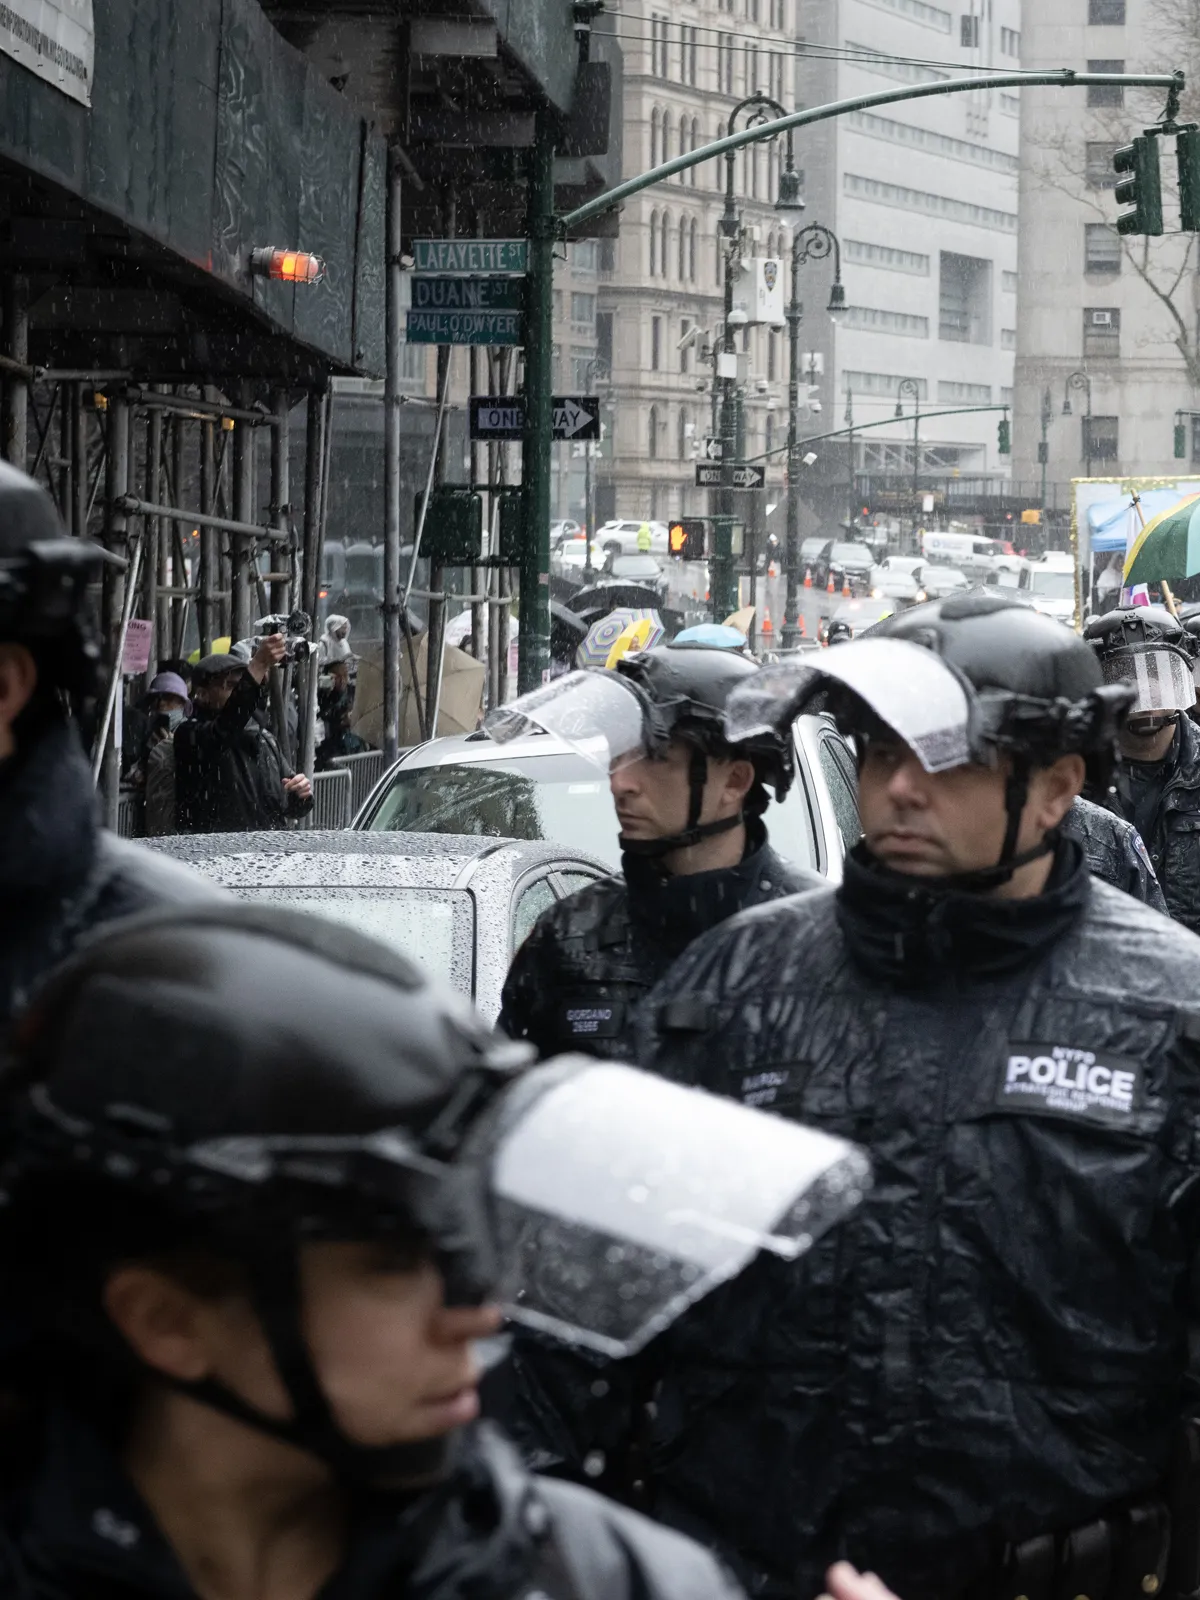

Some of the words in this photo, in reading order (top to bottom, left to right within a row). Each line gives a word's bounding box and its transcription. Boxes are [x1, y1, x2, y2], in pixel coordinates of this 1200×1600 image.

[416, 243, 507, 269] LAFAYETTE
[509, 243, 522, 257] ST
[416, 281, 489, 306] DUANE
[496, 282, 509, 295] ST
[409, 314, 445, 332] PAUL
[450, 315, 516, 333] O'DWYER
[1052, 1046, 1097, 1066] NYPD
[1006, 1055, 1137, 1101] POLICE
